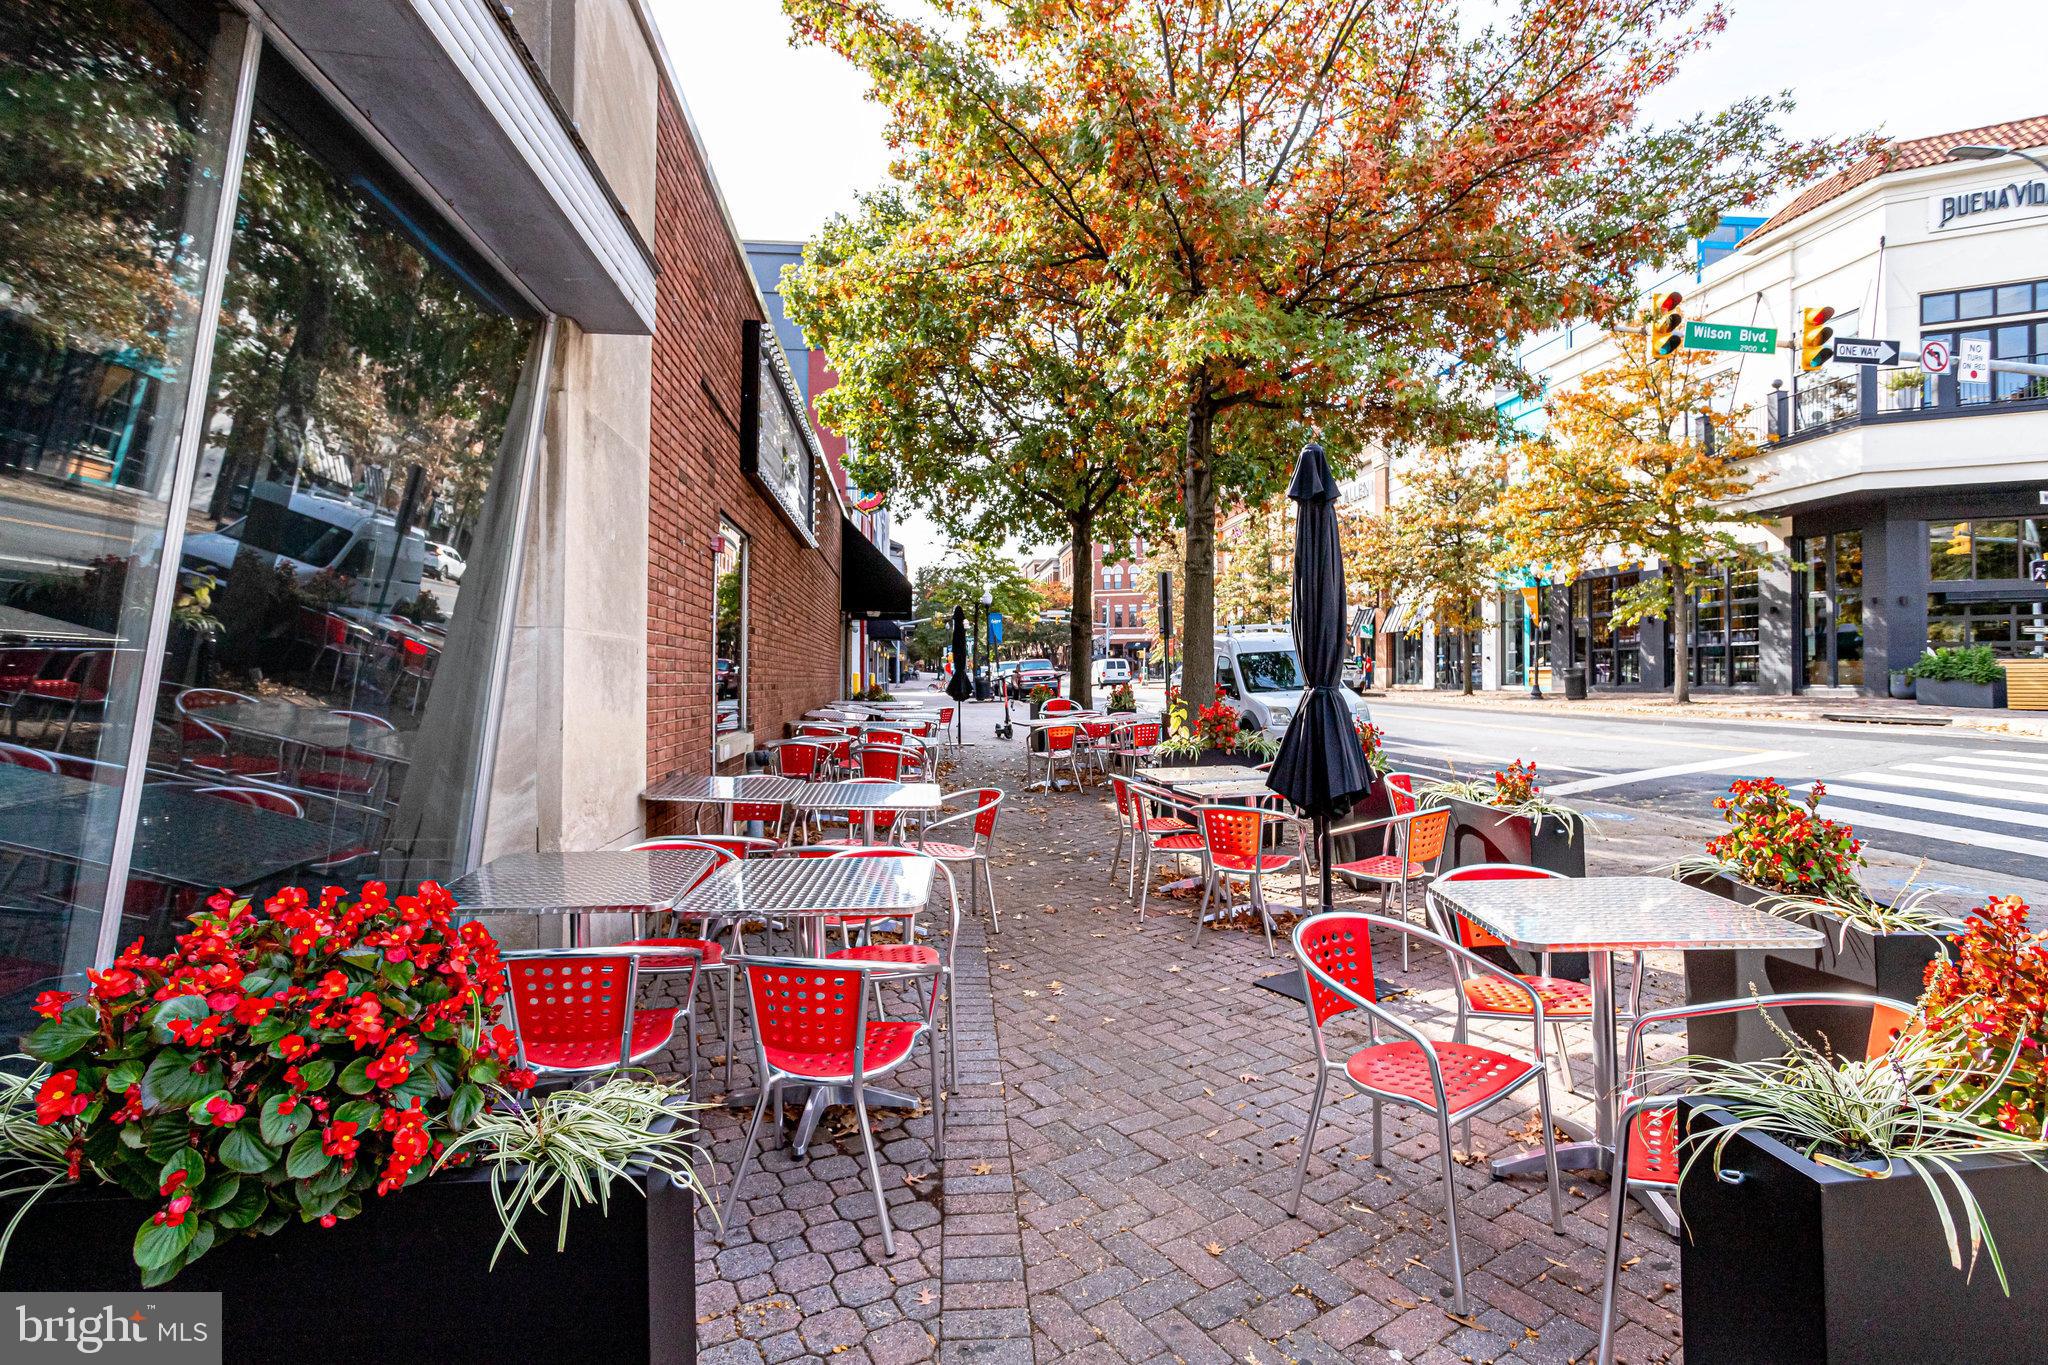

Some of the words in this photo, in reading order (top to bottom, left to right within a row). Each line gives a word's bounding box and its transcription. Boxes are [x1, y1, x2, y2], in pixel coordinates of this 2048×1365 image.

[1694, 325, 1732, 340] Wilson
[1739, 329, 1769, 343] Blvd.
[1739, 344, 1757, 352] 2900
[1839, 345, 1856, 356] ONE
[1860, 345, 1879, 356] WAY
[1969, 344, 1982, 353] NO
[1967, 354, 1983, 362] TURN
[1974, 363, 1986, 371] RED
